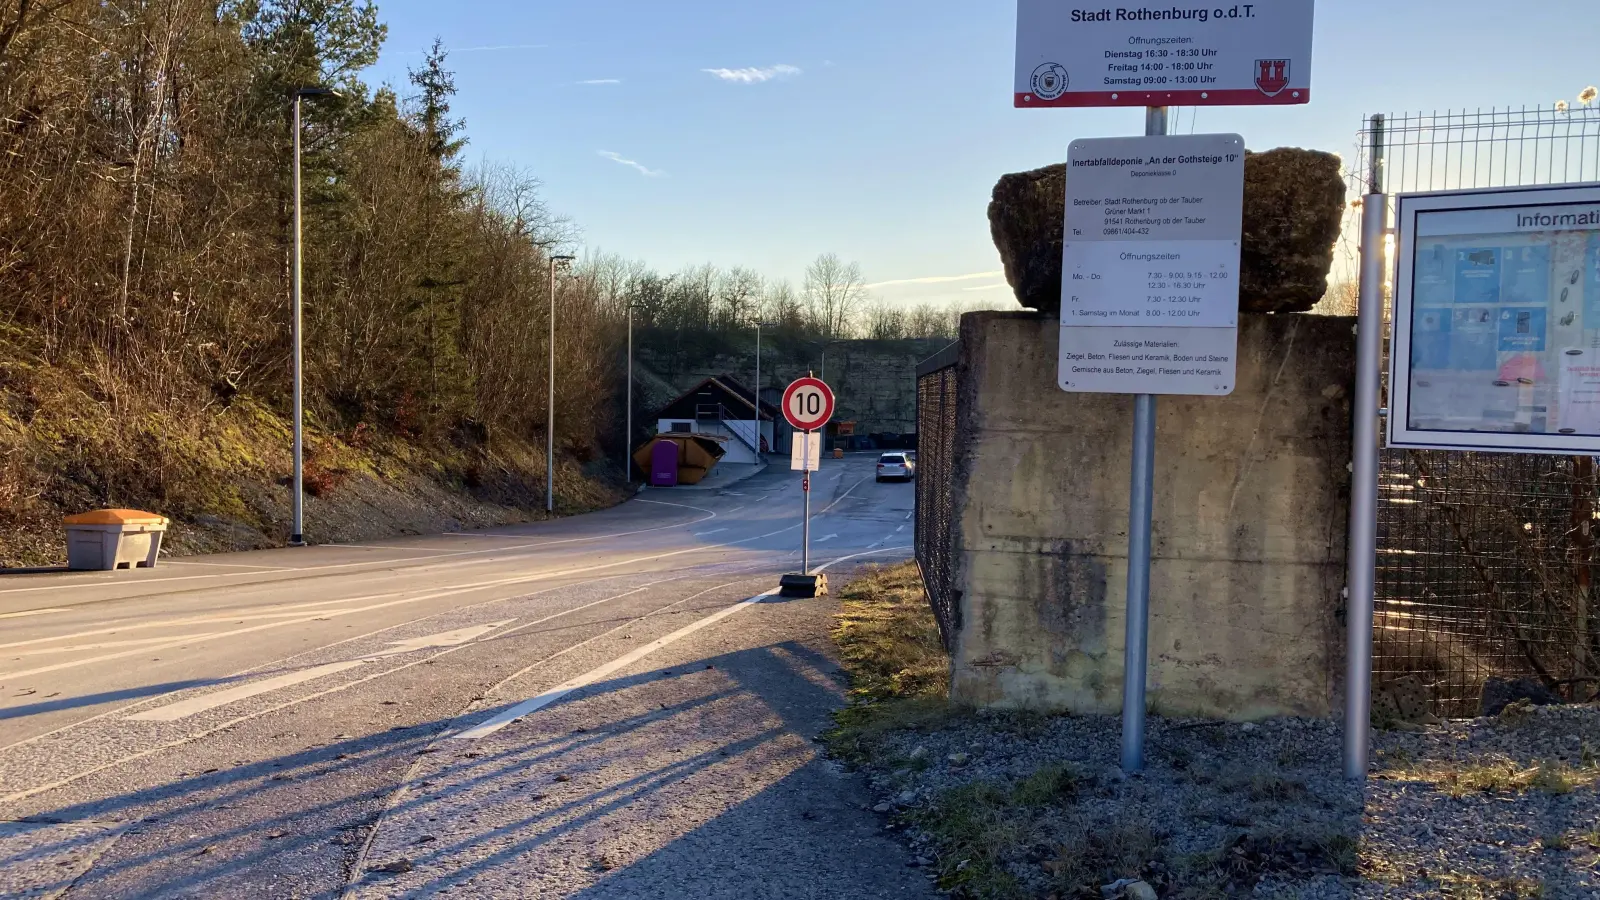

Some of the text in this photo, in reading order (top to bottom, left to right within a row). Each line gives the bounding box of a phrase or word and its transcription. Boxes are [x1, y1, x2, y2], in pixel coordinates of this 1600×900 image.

[1070, 5, 1255, 23] Stadt Rothenburg o.d.T.
[1104, 49, 1143, 60] Dienstag
[1145, 49, 1168, 58] 16:30
[1176, 48, 1199, 57] 18:30
[1201, 48, 1218, 57] Uhr
[1108, 63, 1138, 73] Freitag
[1140, 63, 1164, 72] 14:00
[1171, 62, 1195, 71] 18:00
[1197, 62, 1213, 71] Uhr
[1103, 76, 1141, 86] Samstag
[1143, 76, 1167, 85] 09:00
[1175, 76, 1198, 85] 13:00
[1200, 75, 1217, 84] Uhr
[1072, 158, 1143, 167] Inertabfalldeponie
[1144, 156, 1160, 166] „An
[1162, 156, 1176, 164] der
[1177, 155, 1223, 165] Gothsteige
[1130, 170, 1172, 178] Deponieklasse
[1104, 197, 1121, 205] Stadt
[1122, 197, 1158, 206] Rothenburg
[1169, 196, 1180, 204] der
[1181, 196, 1203, 204] Tauber
[1104, 207, 1126, 216] Grüner
[1127, 207, 1146, 215] Markt
[1104, 217, 1123, 225] 91541
[1124, 217, 1161, 226] Rothenburg
[1162, 217, 1171, 225] ob
[1184, 216, 1206, 224] Tauber
[1103, 228, 1149, 236] 09861/404-432
[1119, 252, 1181, 262] Öffnungszeiten
[1071, 295, 1080, 303] Fr.
[1078, 309, 1108, 318] Samstag
[1119, 309, 1140, 317] Monat
[1113, 340, 1143, 349] Zulässige
[1066, 352, 1086, 361] Ziegel,
[1108, 353, 1131, 361] Fliesen
[1131, 353, 1144, 361] und
[1145, 353, 1172, 362] Keramik,
[1173, 354, 1194, 362] Boden
[1194, 354, 1207, 362] und
[1071, 366, 1102, 374] Gemische
[1115, 367, 1135, 375] Beton,
[1136, 367, 1157, 376] Ziegel,
[1158, 367, 1181, 375] Fliesen
[1182, 368, 1194, 376] und
[1195, 368, 1222, 376] Keramik
[796, 392, 820, 415] 10
